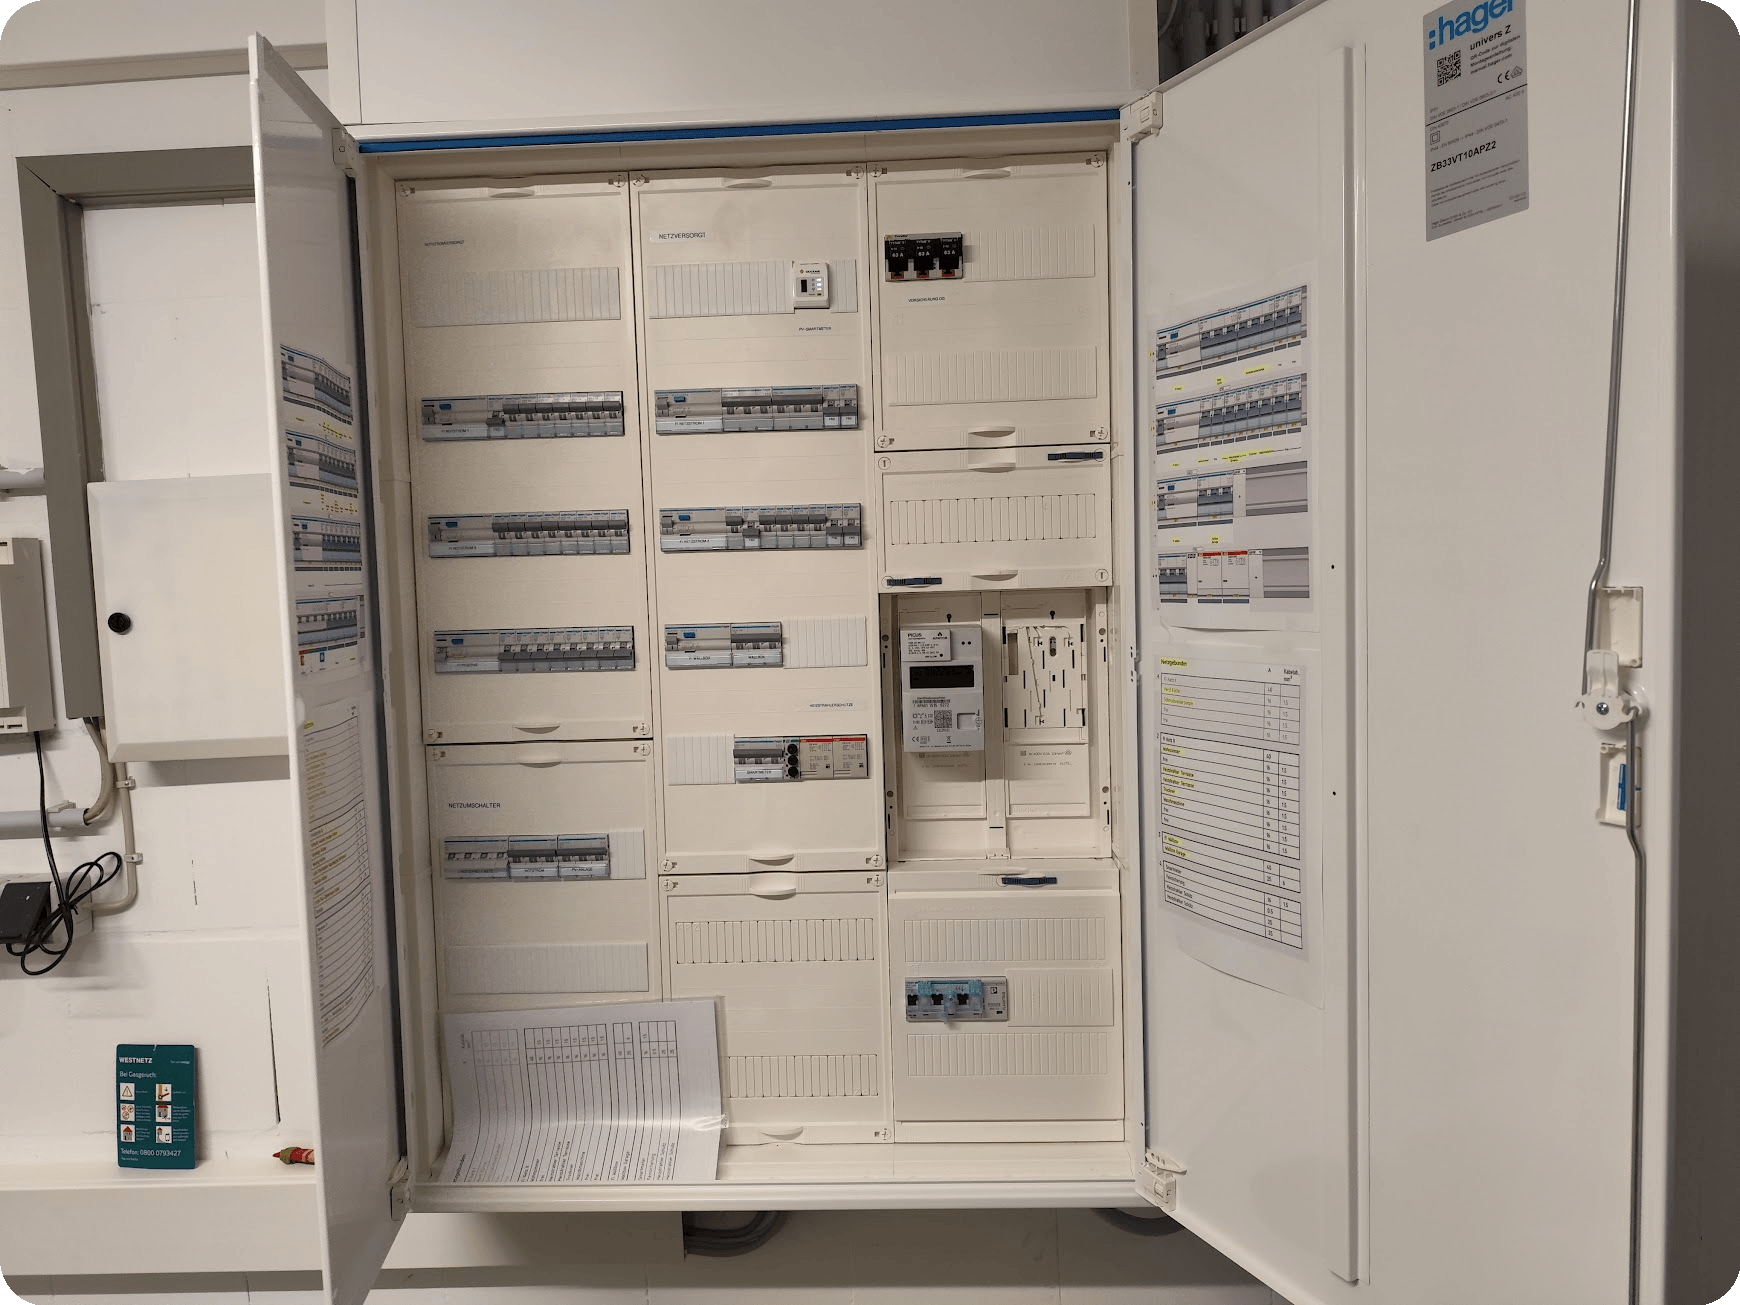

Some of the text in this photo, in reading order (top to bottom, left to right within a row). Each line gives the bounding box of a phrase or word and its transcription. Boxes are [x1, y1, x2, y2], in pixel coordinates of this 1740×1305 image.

[1470, 24, 1511, 50] univers Z
[1430, 140, 1496, 172] ZB33VT10APZ2
